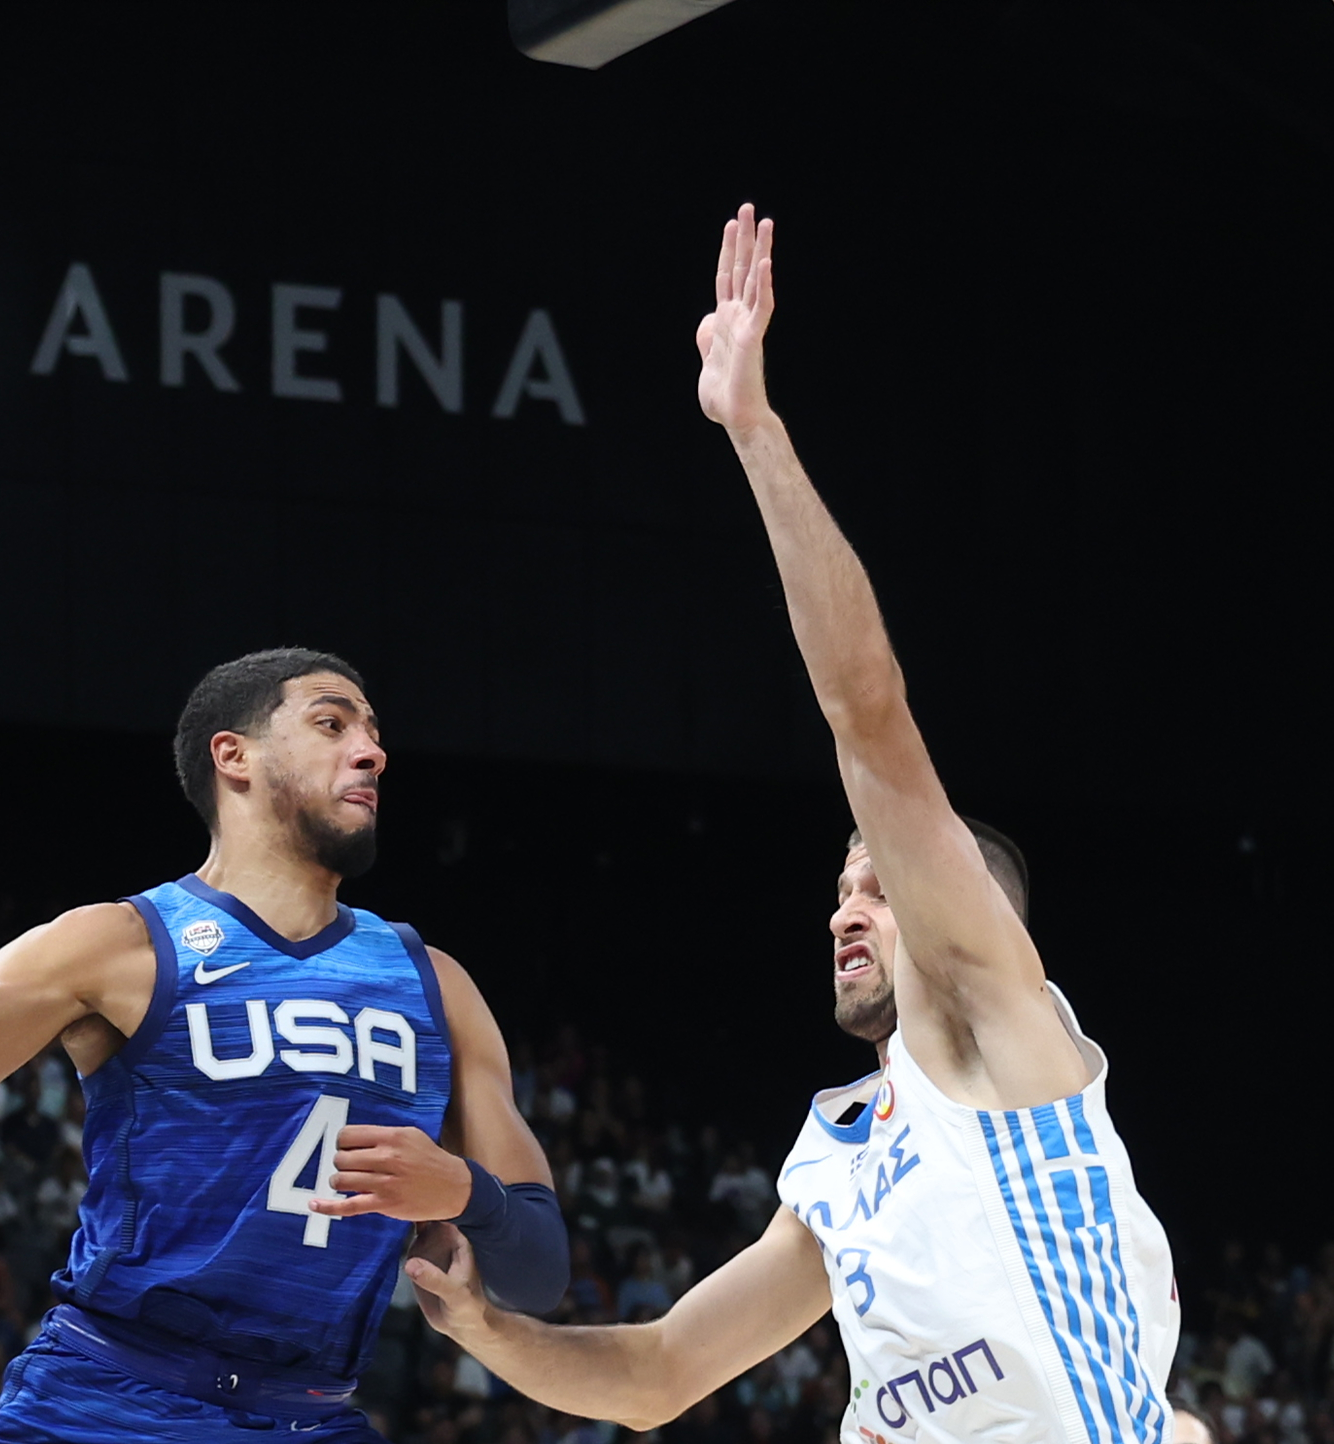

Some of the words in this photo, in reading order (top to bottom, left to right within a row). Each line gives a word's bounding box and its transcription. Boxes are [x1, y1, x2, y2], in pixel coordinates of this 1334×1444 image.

[30, 262, 587, 425] ARENA
[186, 1000, 416, 1094] USA
[267, 1094, 350, 1248] 4
